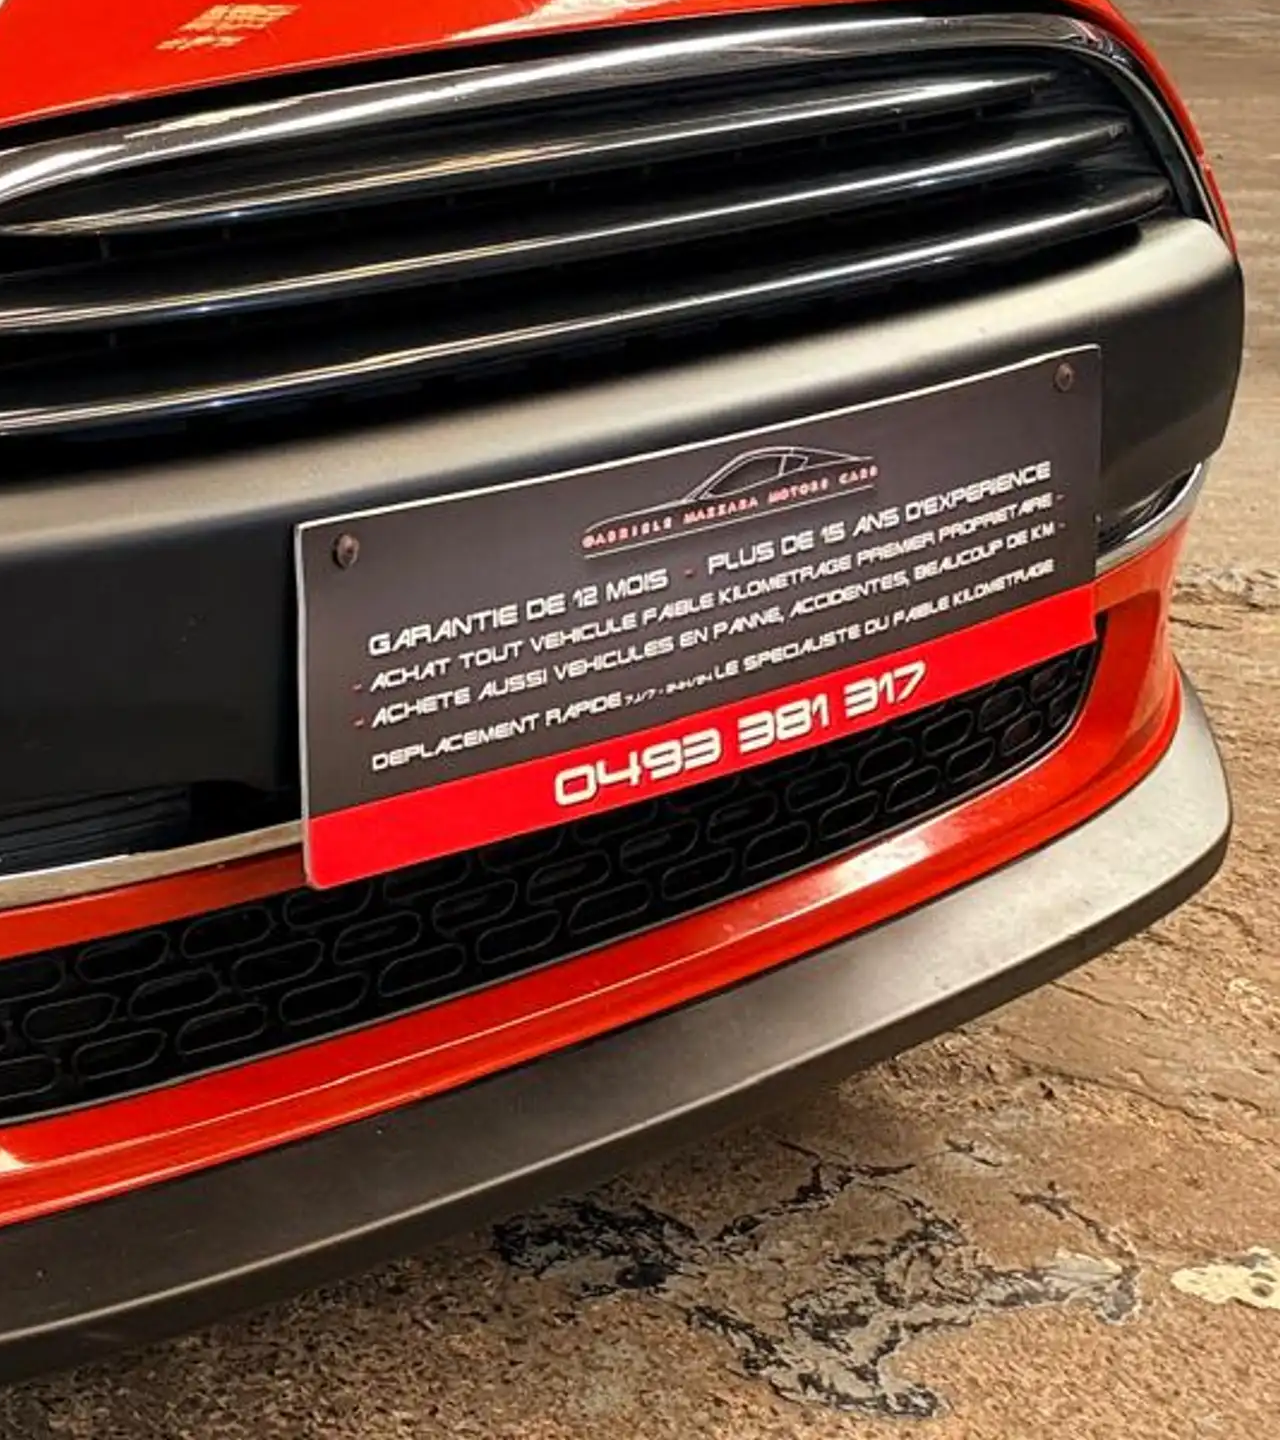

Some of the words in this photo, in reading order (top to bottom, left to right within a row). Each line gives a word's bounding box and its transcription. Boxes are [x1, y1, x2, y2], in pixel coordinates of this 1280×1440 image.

[367, 603, 519, 658] GARANTIE
[525, 592, 567, 622] DE
[572, 584, 599, 610] 12
[605, 568, 669, 603] MOIS
[707, 539, 775, 576] PLUS
[780, 529, 815, 557] DE
[820, 520, 847, 545] 15
[851, 506, 901, 538] ANS
[904, 460, 1053, 522] D'EXPERIENCE
[369, 657, 451, 692] ACHAT
[458, 640, 524, 670] TOUT
[529, 611, 638, 655] VEHICULE
[642, 591, 716, 626] FAIBLE
[717, 553, 853, 606] KILOMETRAGE
[856, 530, 937, 566] PREMIER
[938, 491, 1054, 544] PROPRIETAIRE
[370, 686, 472, 729] ACHETE
[477, 667, 548, 702] AUSSI
[552, 634, 675, 682] VEHICULES
[678, 625, 710, 649] EN
[712, 605, 785, 640] PANNE,
[788, 569, 910, 619] ACCIDENTES,
[913, 537, 1004, 582] BEAUCOUP
[1005, 529, 1030, 551] DE
[371, 712, 541, 773] DEPLACEMENT
[544, 690, 623, 728] RAPIDE
[713, 658, 740, 680] LE
[742, 623, 863, 673] SPECIALISTE
[864, 614, 890, 637] DU
[892, 593, 951, 627] FAIBLE
[951, 558, 1057, 608] KILOMETRAGE
[553, 727, 724, 808] 0493
[737, 692, 832, 755] 381
[843, 660, 928, 719] 317
